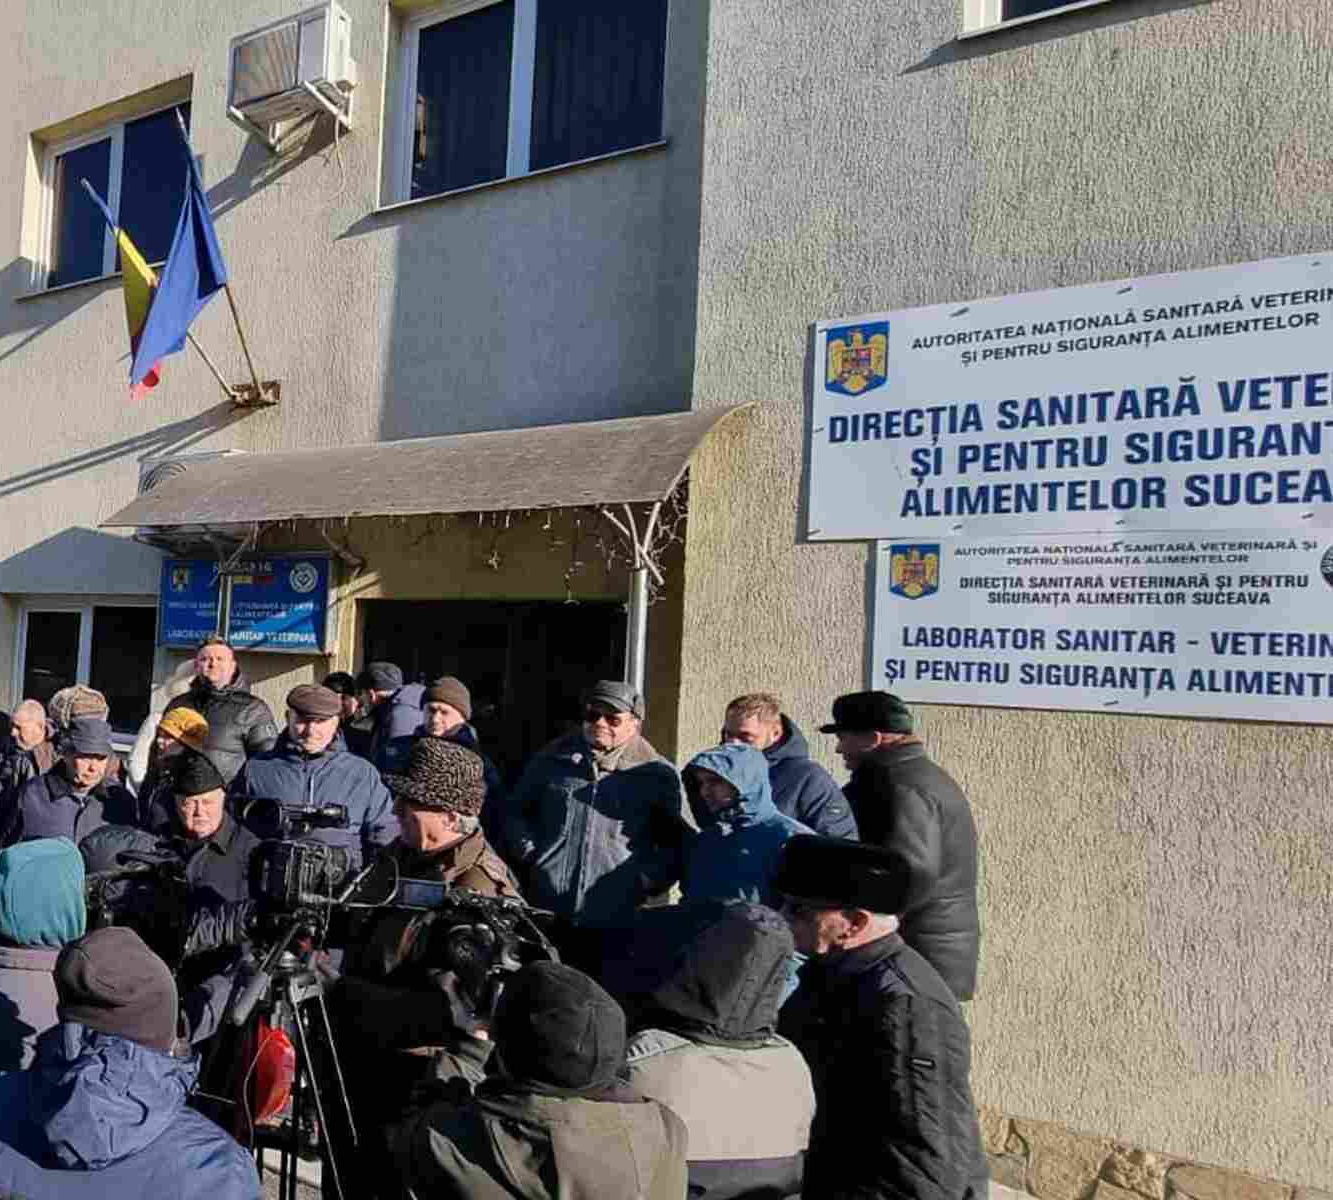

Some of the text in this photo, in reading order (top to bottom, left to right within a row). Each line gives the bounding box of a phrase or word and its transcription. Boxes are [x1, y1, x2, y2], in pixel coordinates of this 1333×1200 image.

[911, 325, 1026, 350] AUTORITATEA
[1031, 308, 1137, 336] NAȚIONALĂ
[1142, 294, 1244, 323] SANITARĂ
[961, 312, 1320, 368] ȘI PENTRU SIGURANȚA ALIMENTELOR
[828, 372, 1333, 445] DIRECȚIA SANITARĂ VETE
[911, 446, 943, 487] ȘI
[958, 434, 1108, 474] PENTRU
[900, 476, 1167, 518] ALIMENTELOR
[953, 546, 1040, 556] AUTORITATEA
[1124, 542, 1196, 553] SANITARĂ
[1200, 540, 1297, 552] VETERINARĂ
[1006, 554, 1249, 567] PENTRU SIGURANȚA ALIMENTELOR
[959, 572, 1309, 591] DIRECȚIA SANITARĂ VETERINARĂ ȘI PENTRU
[987, 592, 1271, 607] SIGURANȚA ALIMENTELOR SUCEAVA
[902, 626, 1045, 651] LABORATOR
[1055, 628, 1177, 654] SANITAR
[885, 658, 1333, 698] ȘI PENTRU SIGURANȚA ALIMENT
